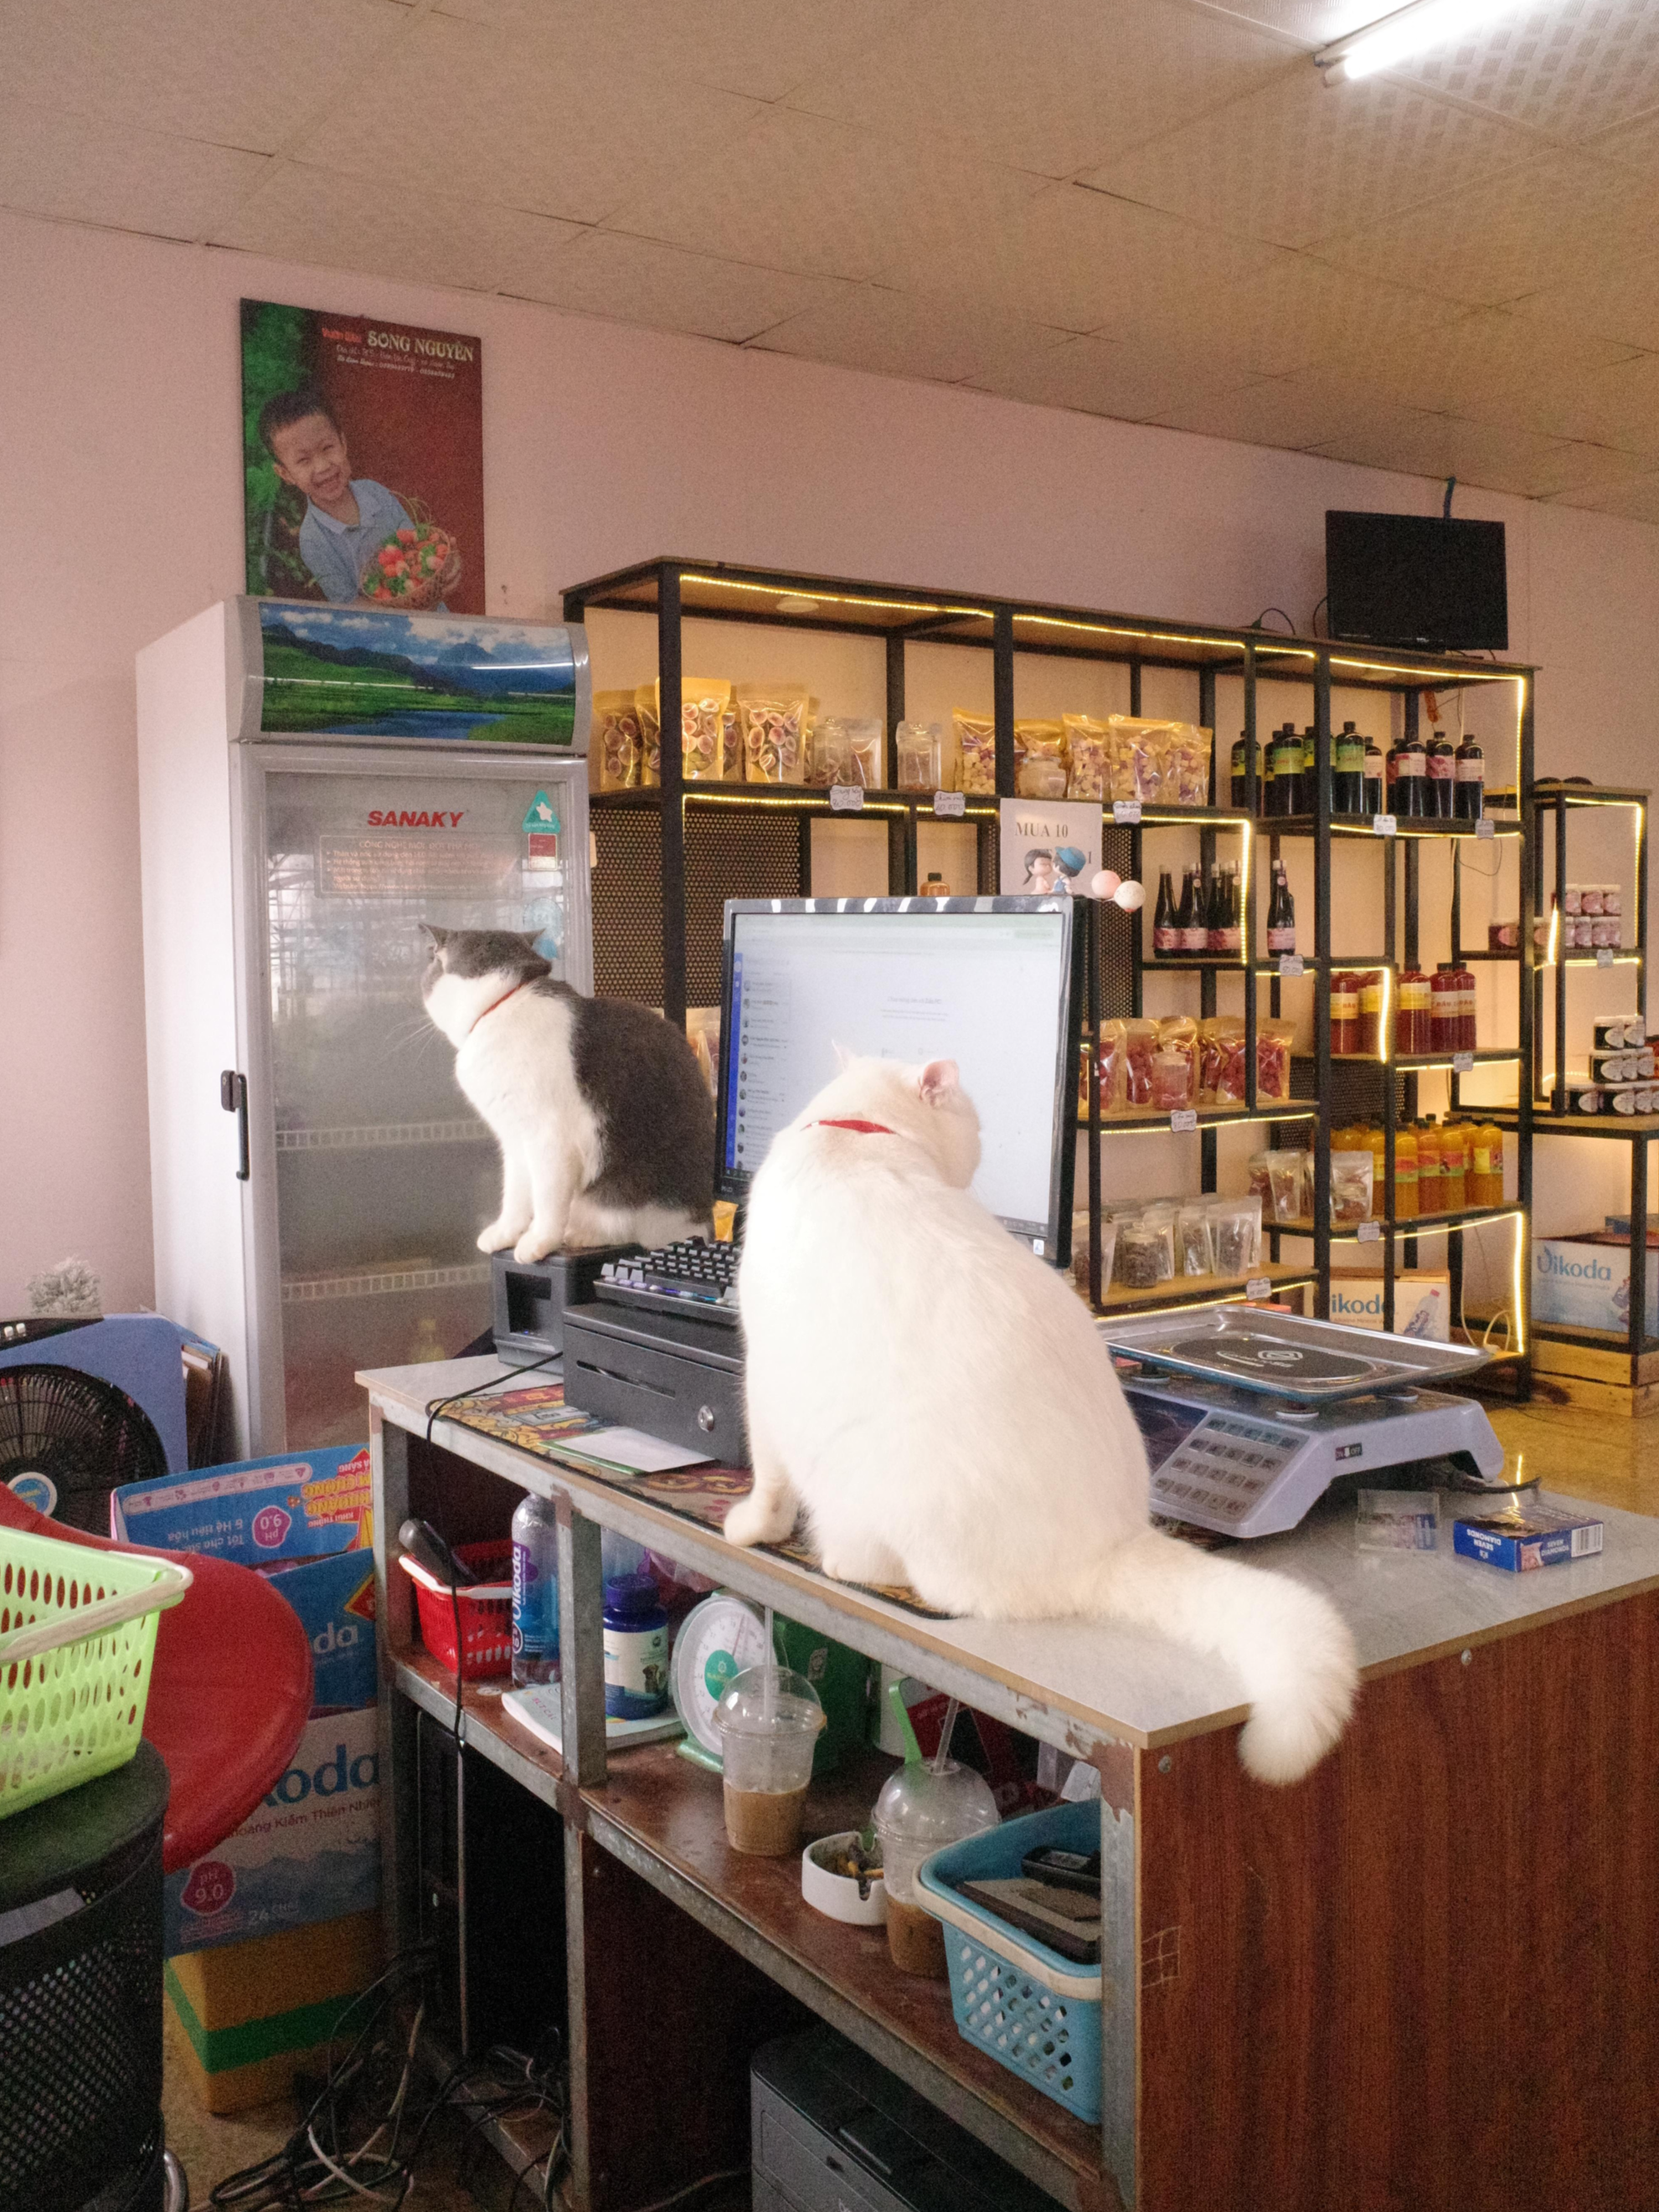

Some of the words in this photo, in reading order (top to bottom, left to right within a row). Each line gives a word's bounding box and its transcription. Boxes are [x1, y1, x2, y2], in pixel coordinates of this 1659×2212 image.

[368, 810, 464, 827] SANAKY
[1015, 822, 1050, 837] MUA
[1055, 824, 1069, 838] 10
[260, 1514, 281, 1530] 9.0
[265, 1528, 279, 1541] pH
[1466, 1529, 1501, 1546] DIAMONDS
[1474, 1539, 1493, 1551] SEVEN
[195, 1883, 224, 1904] 9.0
